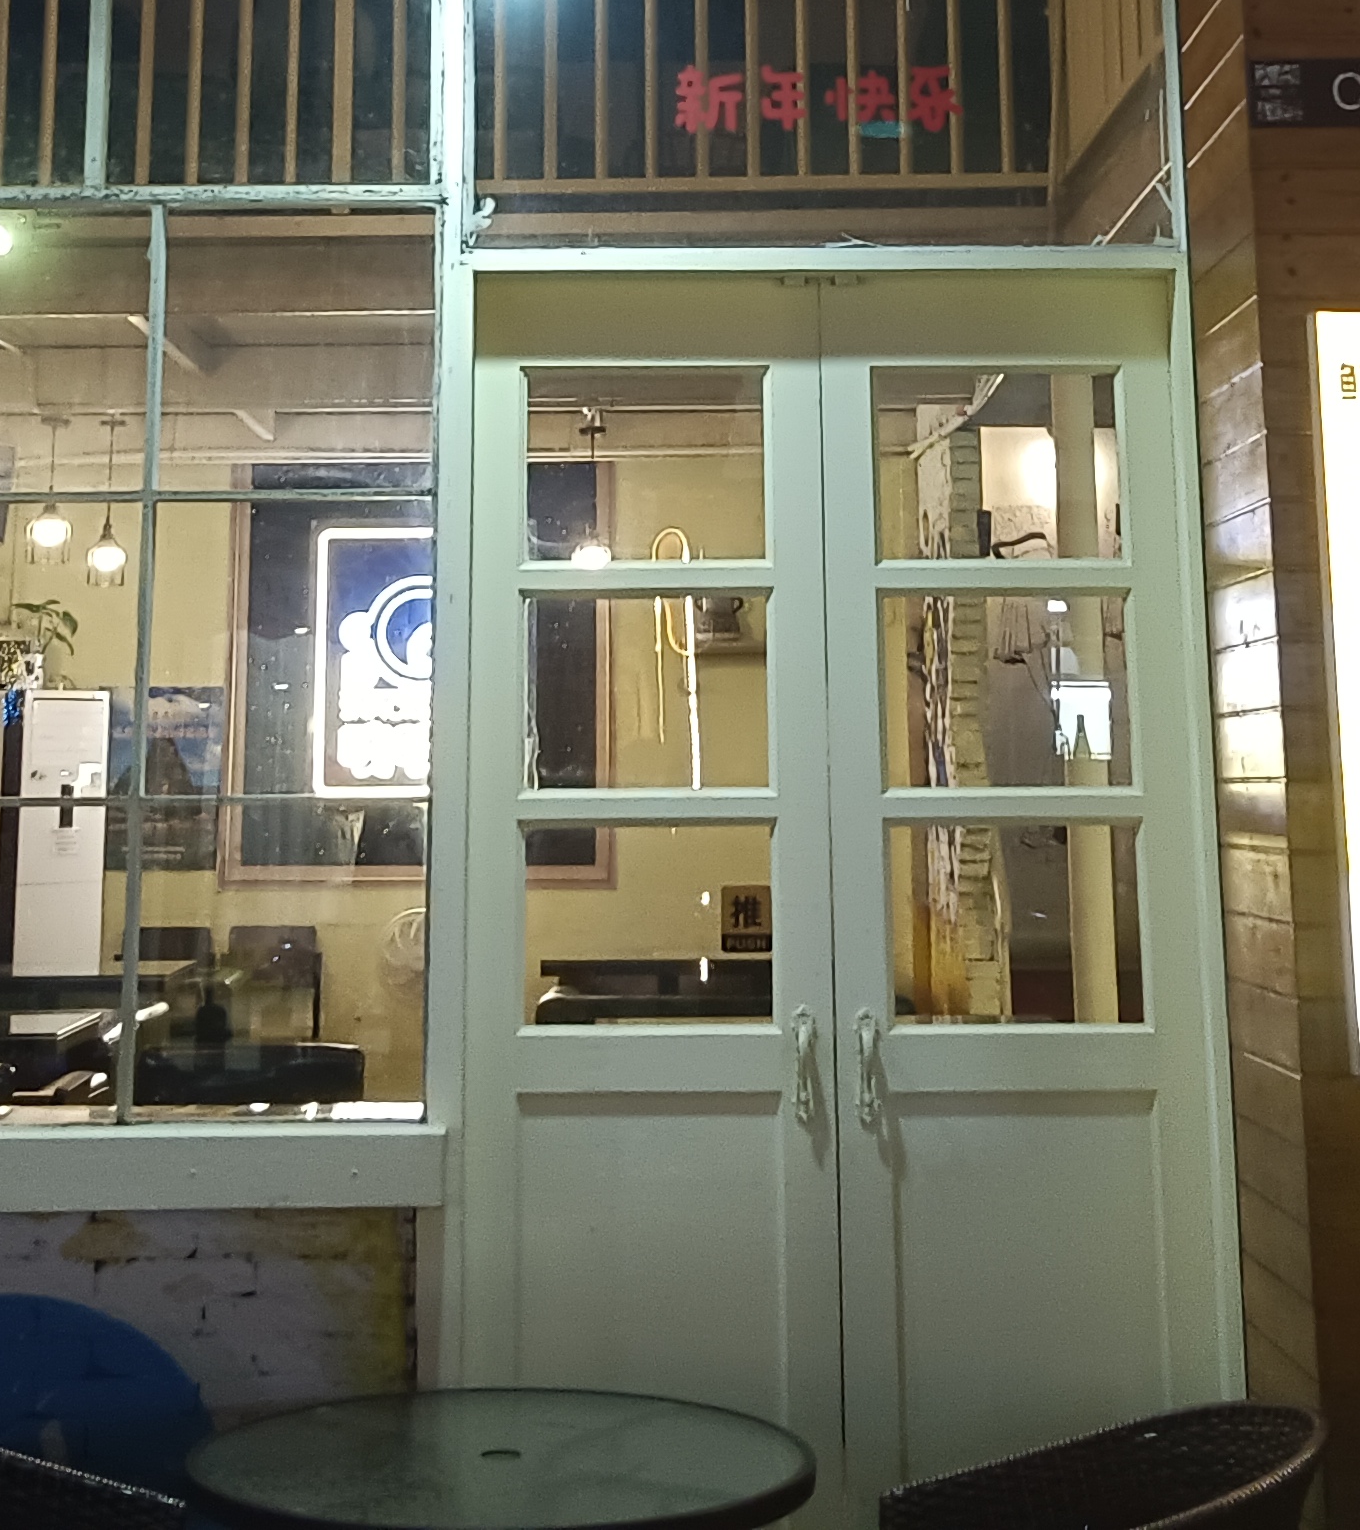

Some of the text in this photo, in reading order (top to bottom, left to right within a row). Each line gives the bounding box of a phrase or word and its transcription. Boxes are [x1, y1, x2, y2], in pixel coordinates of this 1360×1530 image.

[674, 64, 964, 135] 新年快乐
[730, 895, 762, 929] 推
[726, 936, 767, 949] PUSH
